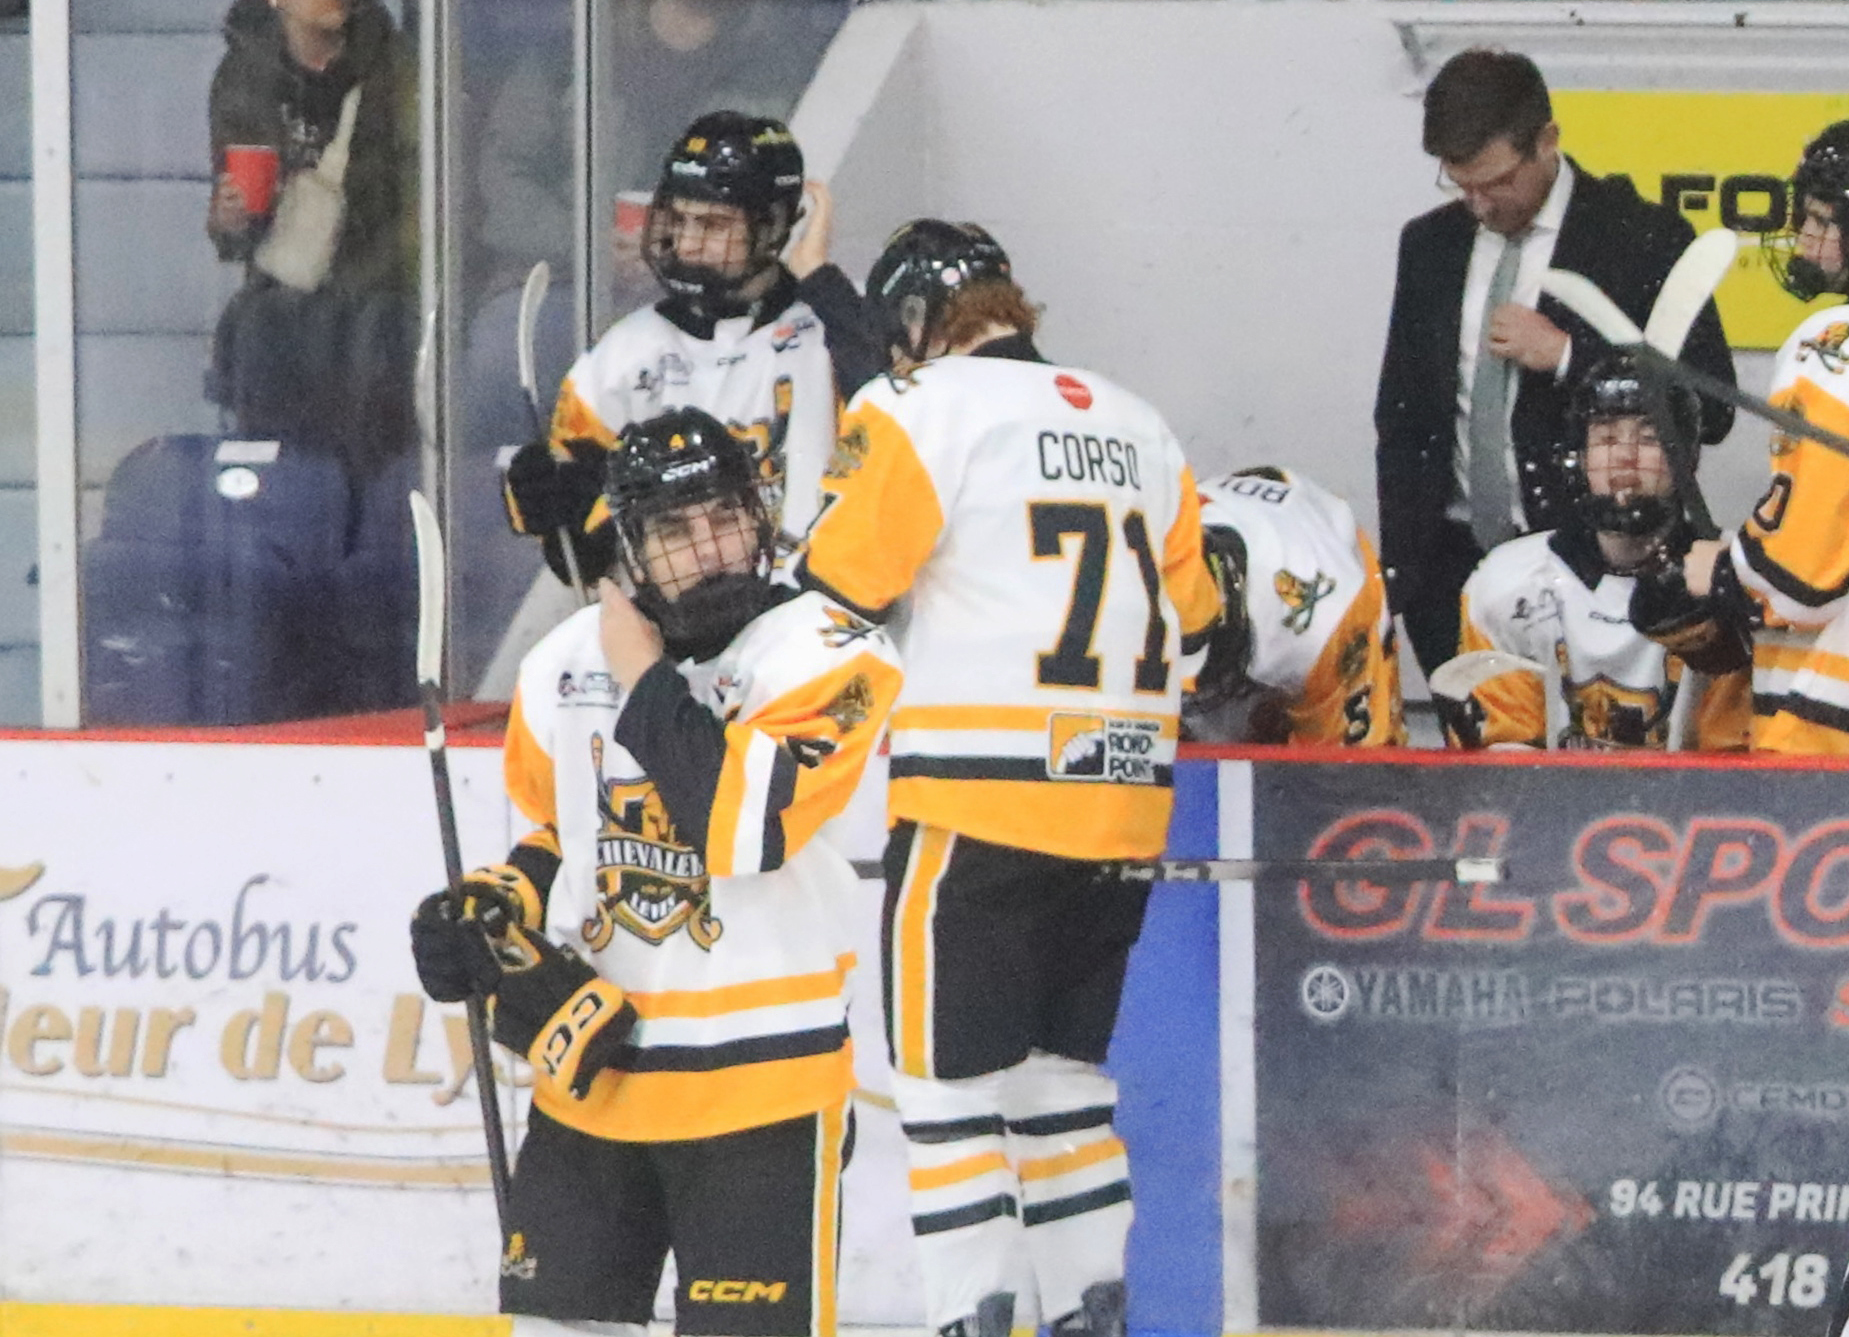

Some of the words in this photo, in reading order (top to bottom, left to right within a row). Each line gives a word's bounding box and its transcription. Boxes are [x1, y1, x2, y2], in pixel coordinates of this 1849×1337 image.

[1037, 429, 1142, 492] CORSO
[1025, 500, 1171, 695] 71
[1299, 808, 1534, 941] GL
[27, 872, 360, 984] Autobus
[1356, 969, 1529, 1019] YAMAHA
[1549, 975, 1802, 1022] POLARIS
[219, 989, 356, 1084] de
[1610, 1178, 1664, 1219] 94
[1673, 1180, 1761, 1222] RUE
[688, 1279, 787, 1304] CCM
[1718, 1251, 1830, 1309] 418
